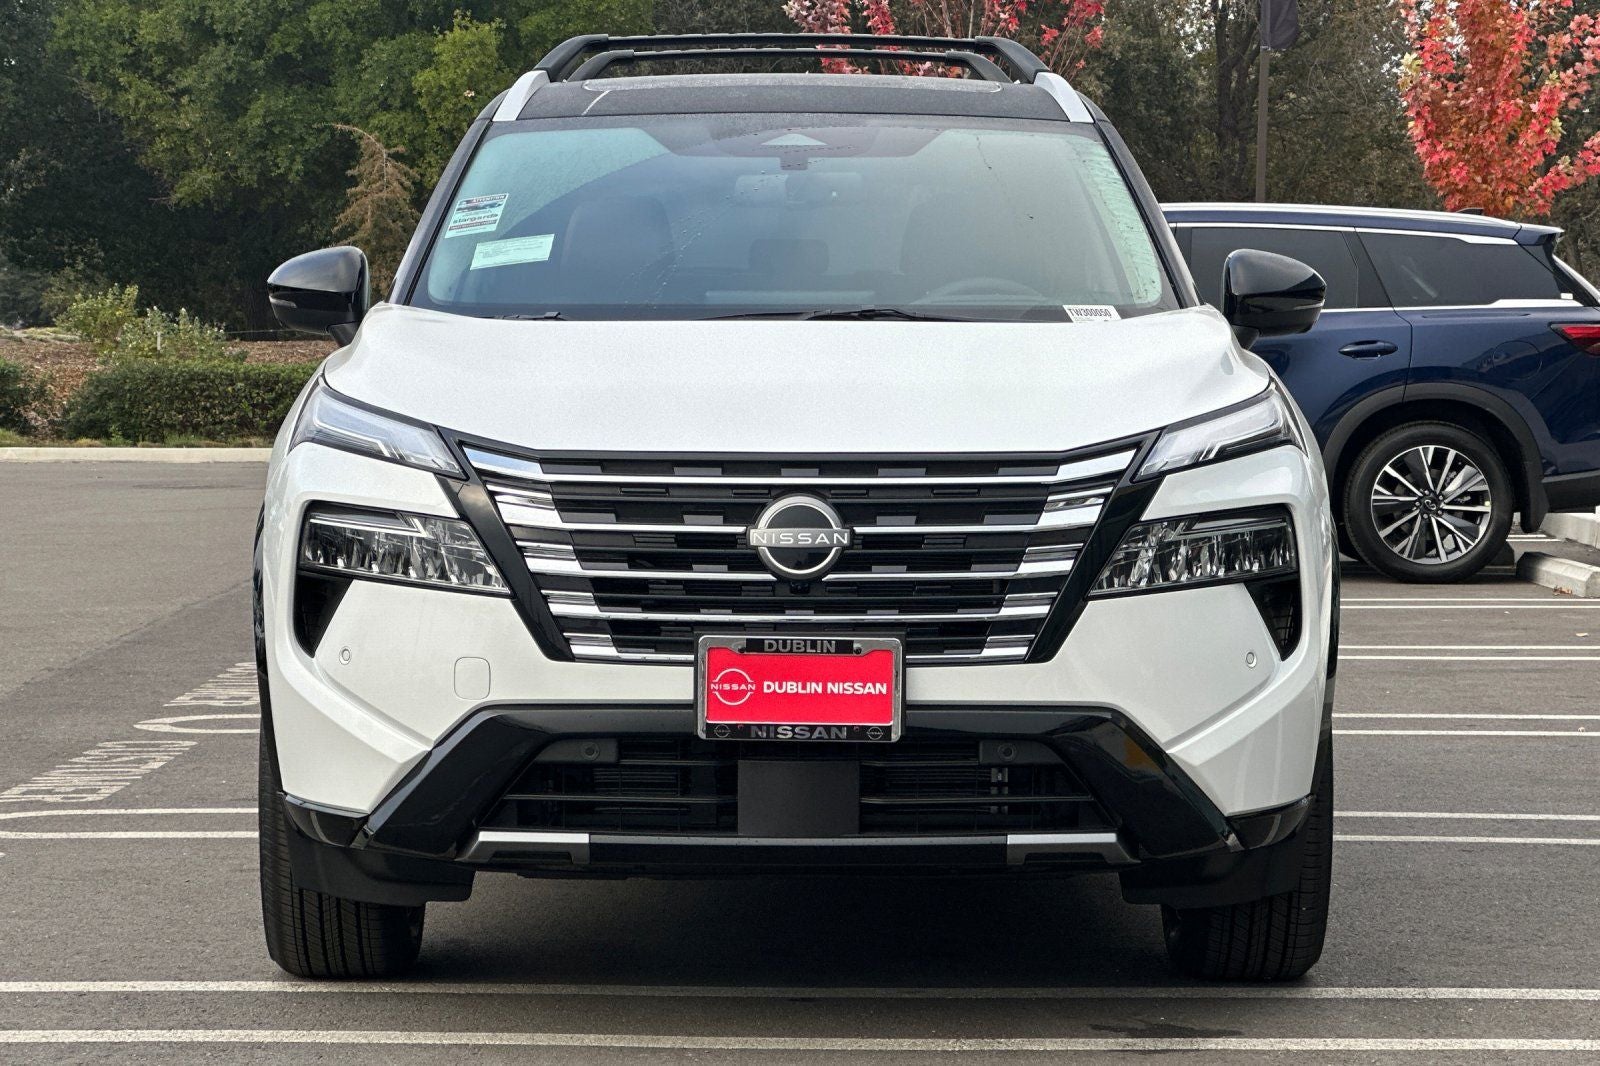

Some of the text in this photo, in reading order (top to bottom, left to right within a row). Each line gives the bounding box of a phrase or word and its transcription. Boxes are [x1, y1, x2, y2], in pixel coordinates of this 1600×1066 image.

[753, 532, 848, 545] NISSAN
[763, 639, 836, 653] DUBLIN
[710, 681, 887, 695] NISSAN DUBLIN NISSAN
[750, 725, 847, 740] NISSAN
